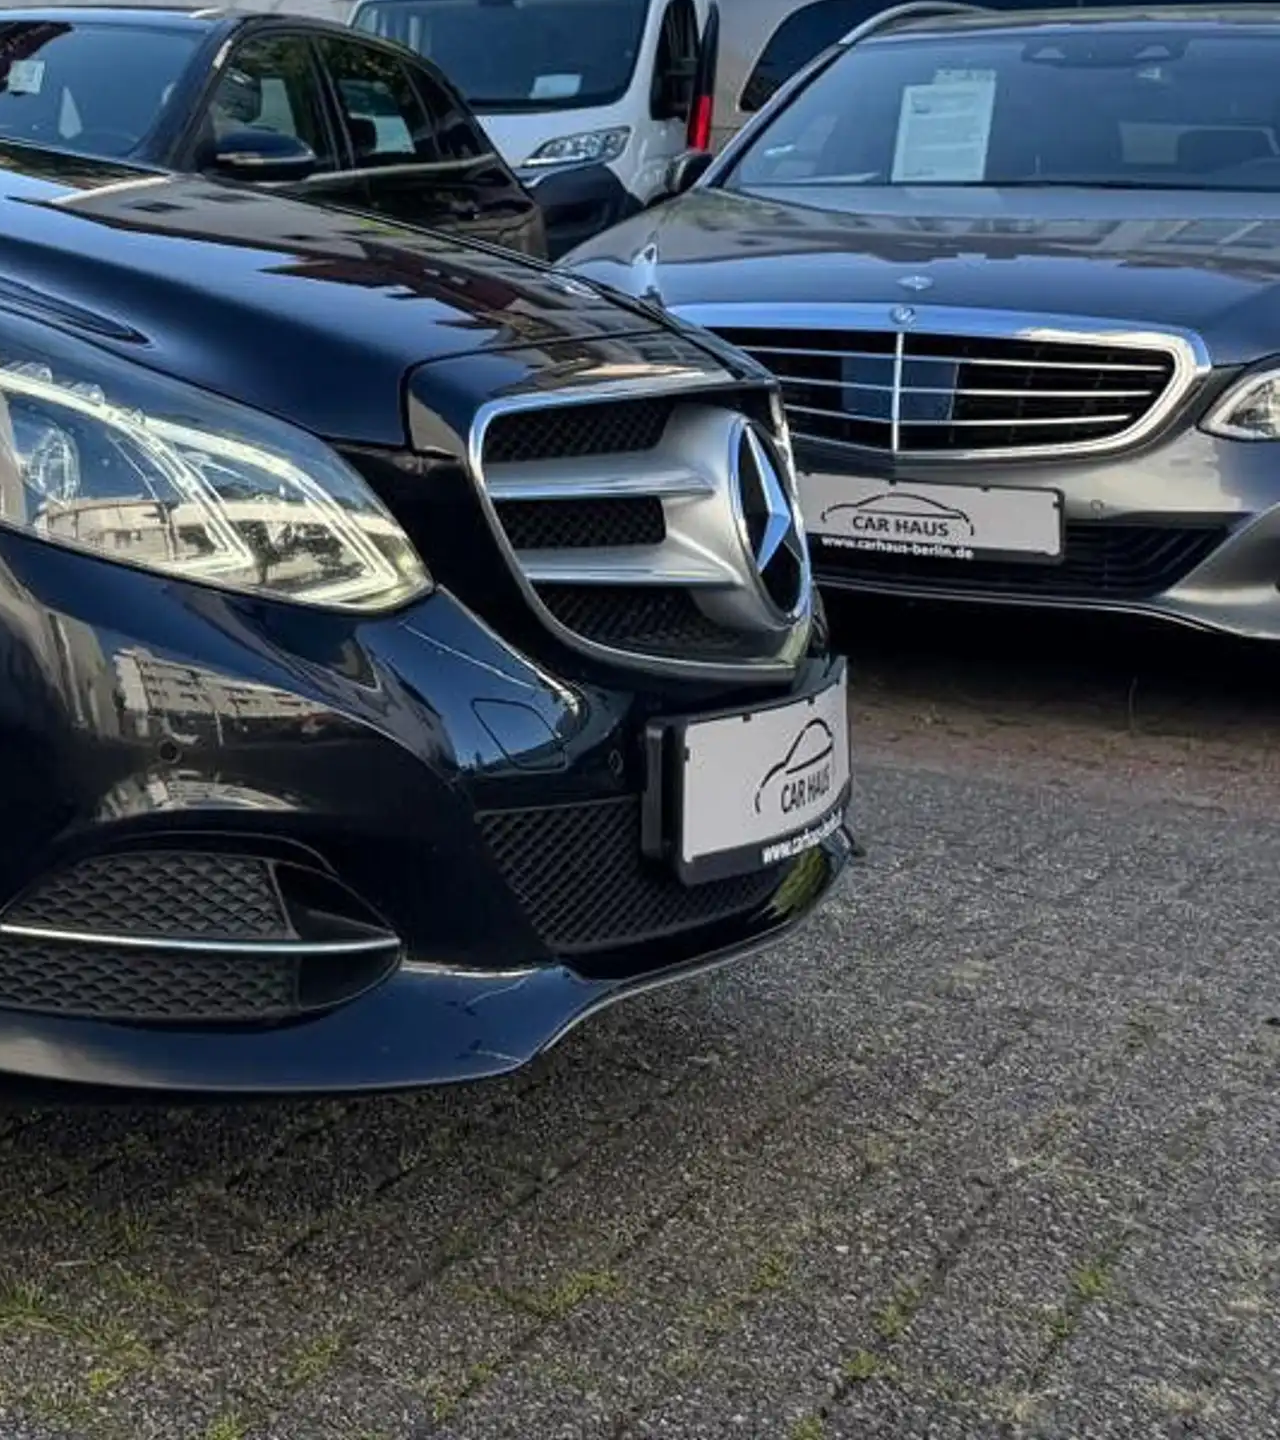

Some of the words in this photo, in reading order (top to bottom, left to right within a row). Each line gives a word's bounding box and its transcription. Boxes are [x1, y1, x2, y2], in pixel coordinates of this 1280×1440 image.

[852, 515, 890, 533] CAR
[895, 519, 949, 537] HAUS
[821, 535, 975, 560] www.carhaus-berlin.de
[781, 779, 806, 813] CAR
